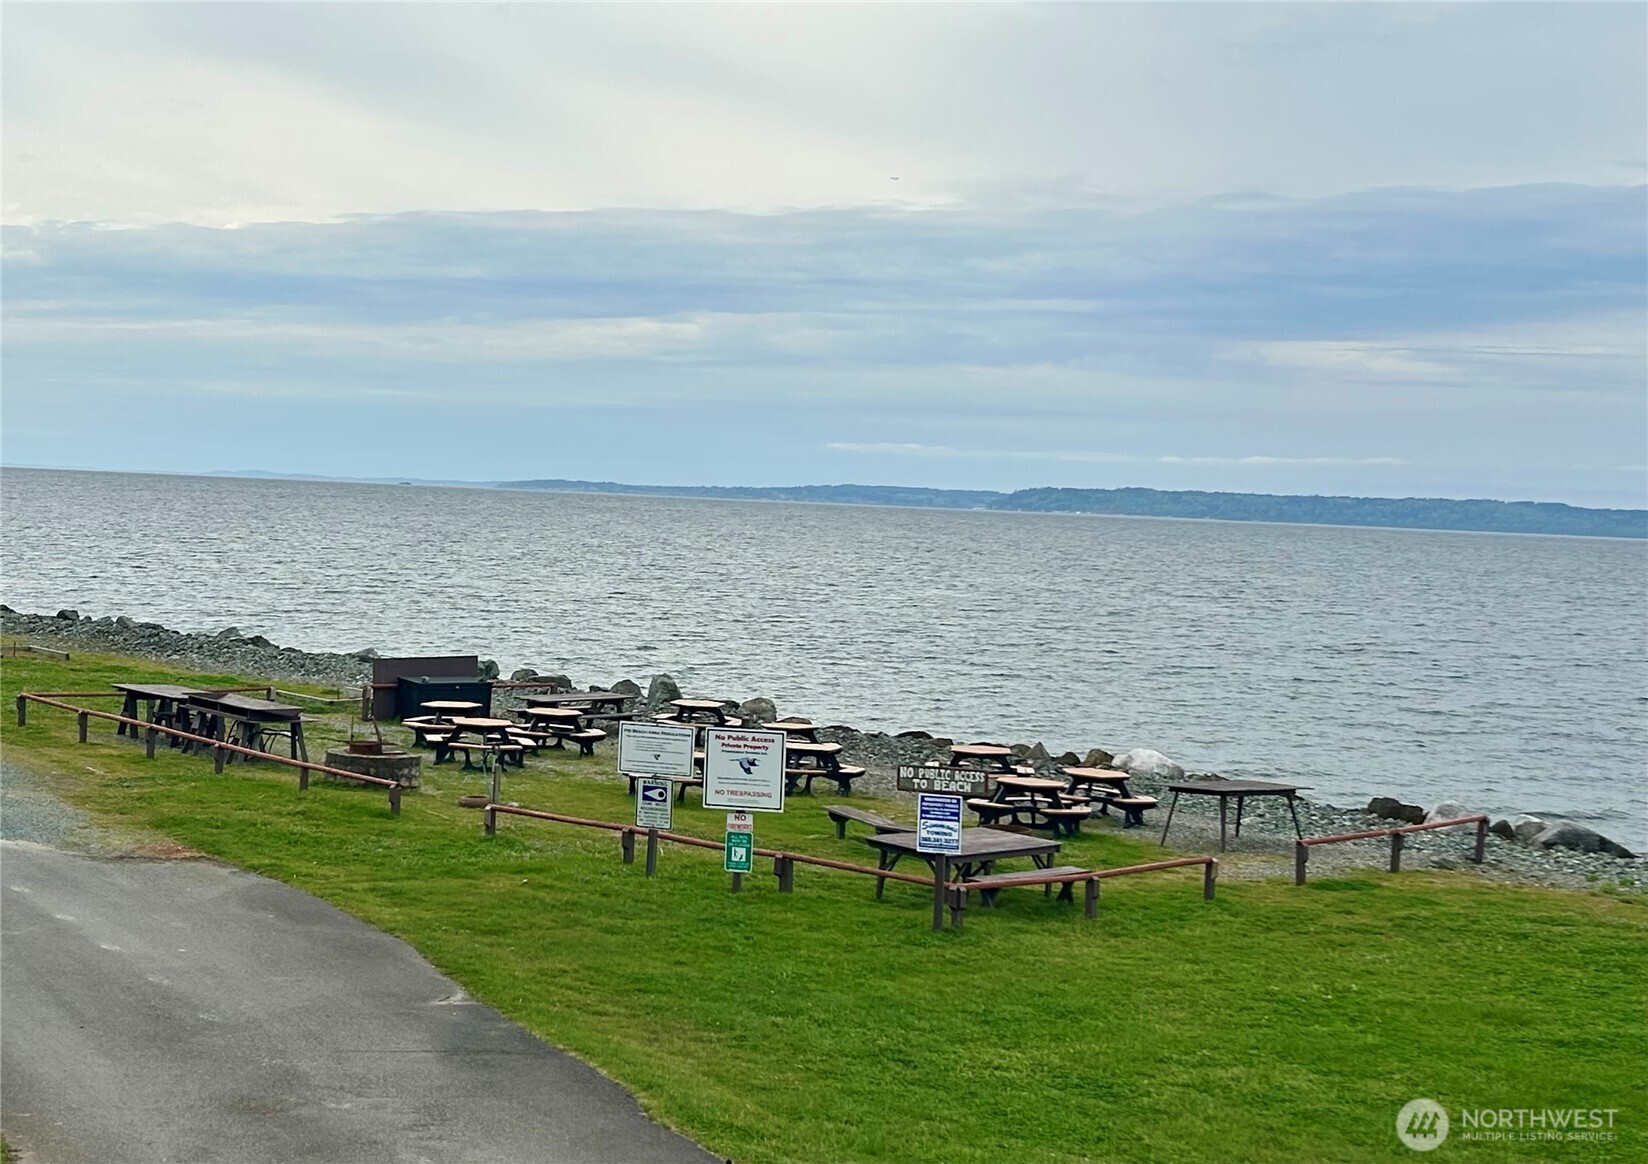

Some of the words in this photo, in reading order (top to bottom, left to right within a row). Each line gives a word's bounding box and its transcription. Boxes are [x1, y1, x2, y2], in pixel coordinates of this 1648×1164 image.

[900, 766, 914, 778] NO
[919, 768, 951, 780] PUBLIC
[954, 771, 985, 782] ACCESS
[912, 778, 928, 789] TO
[934, 780, 971, 792] BEACH
[727, 789, 772, 798] TRESPASSING
